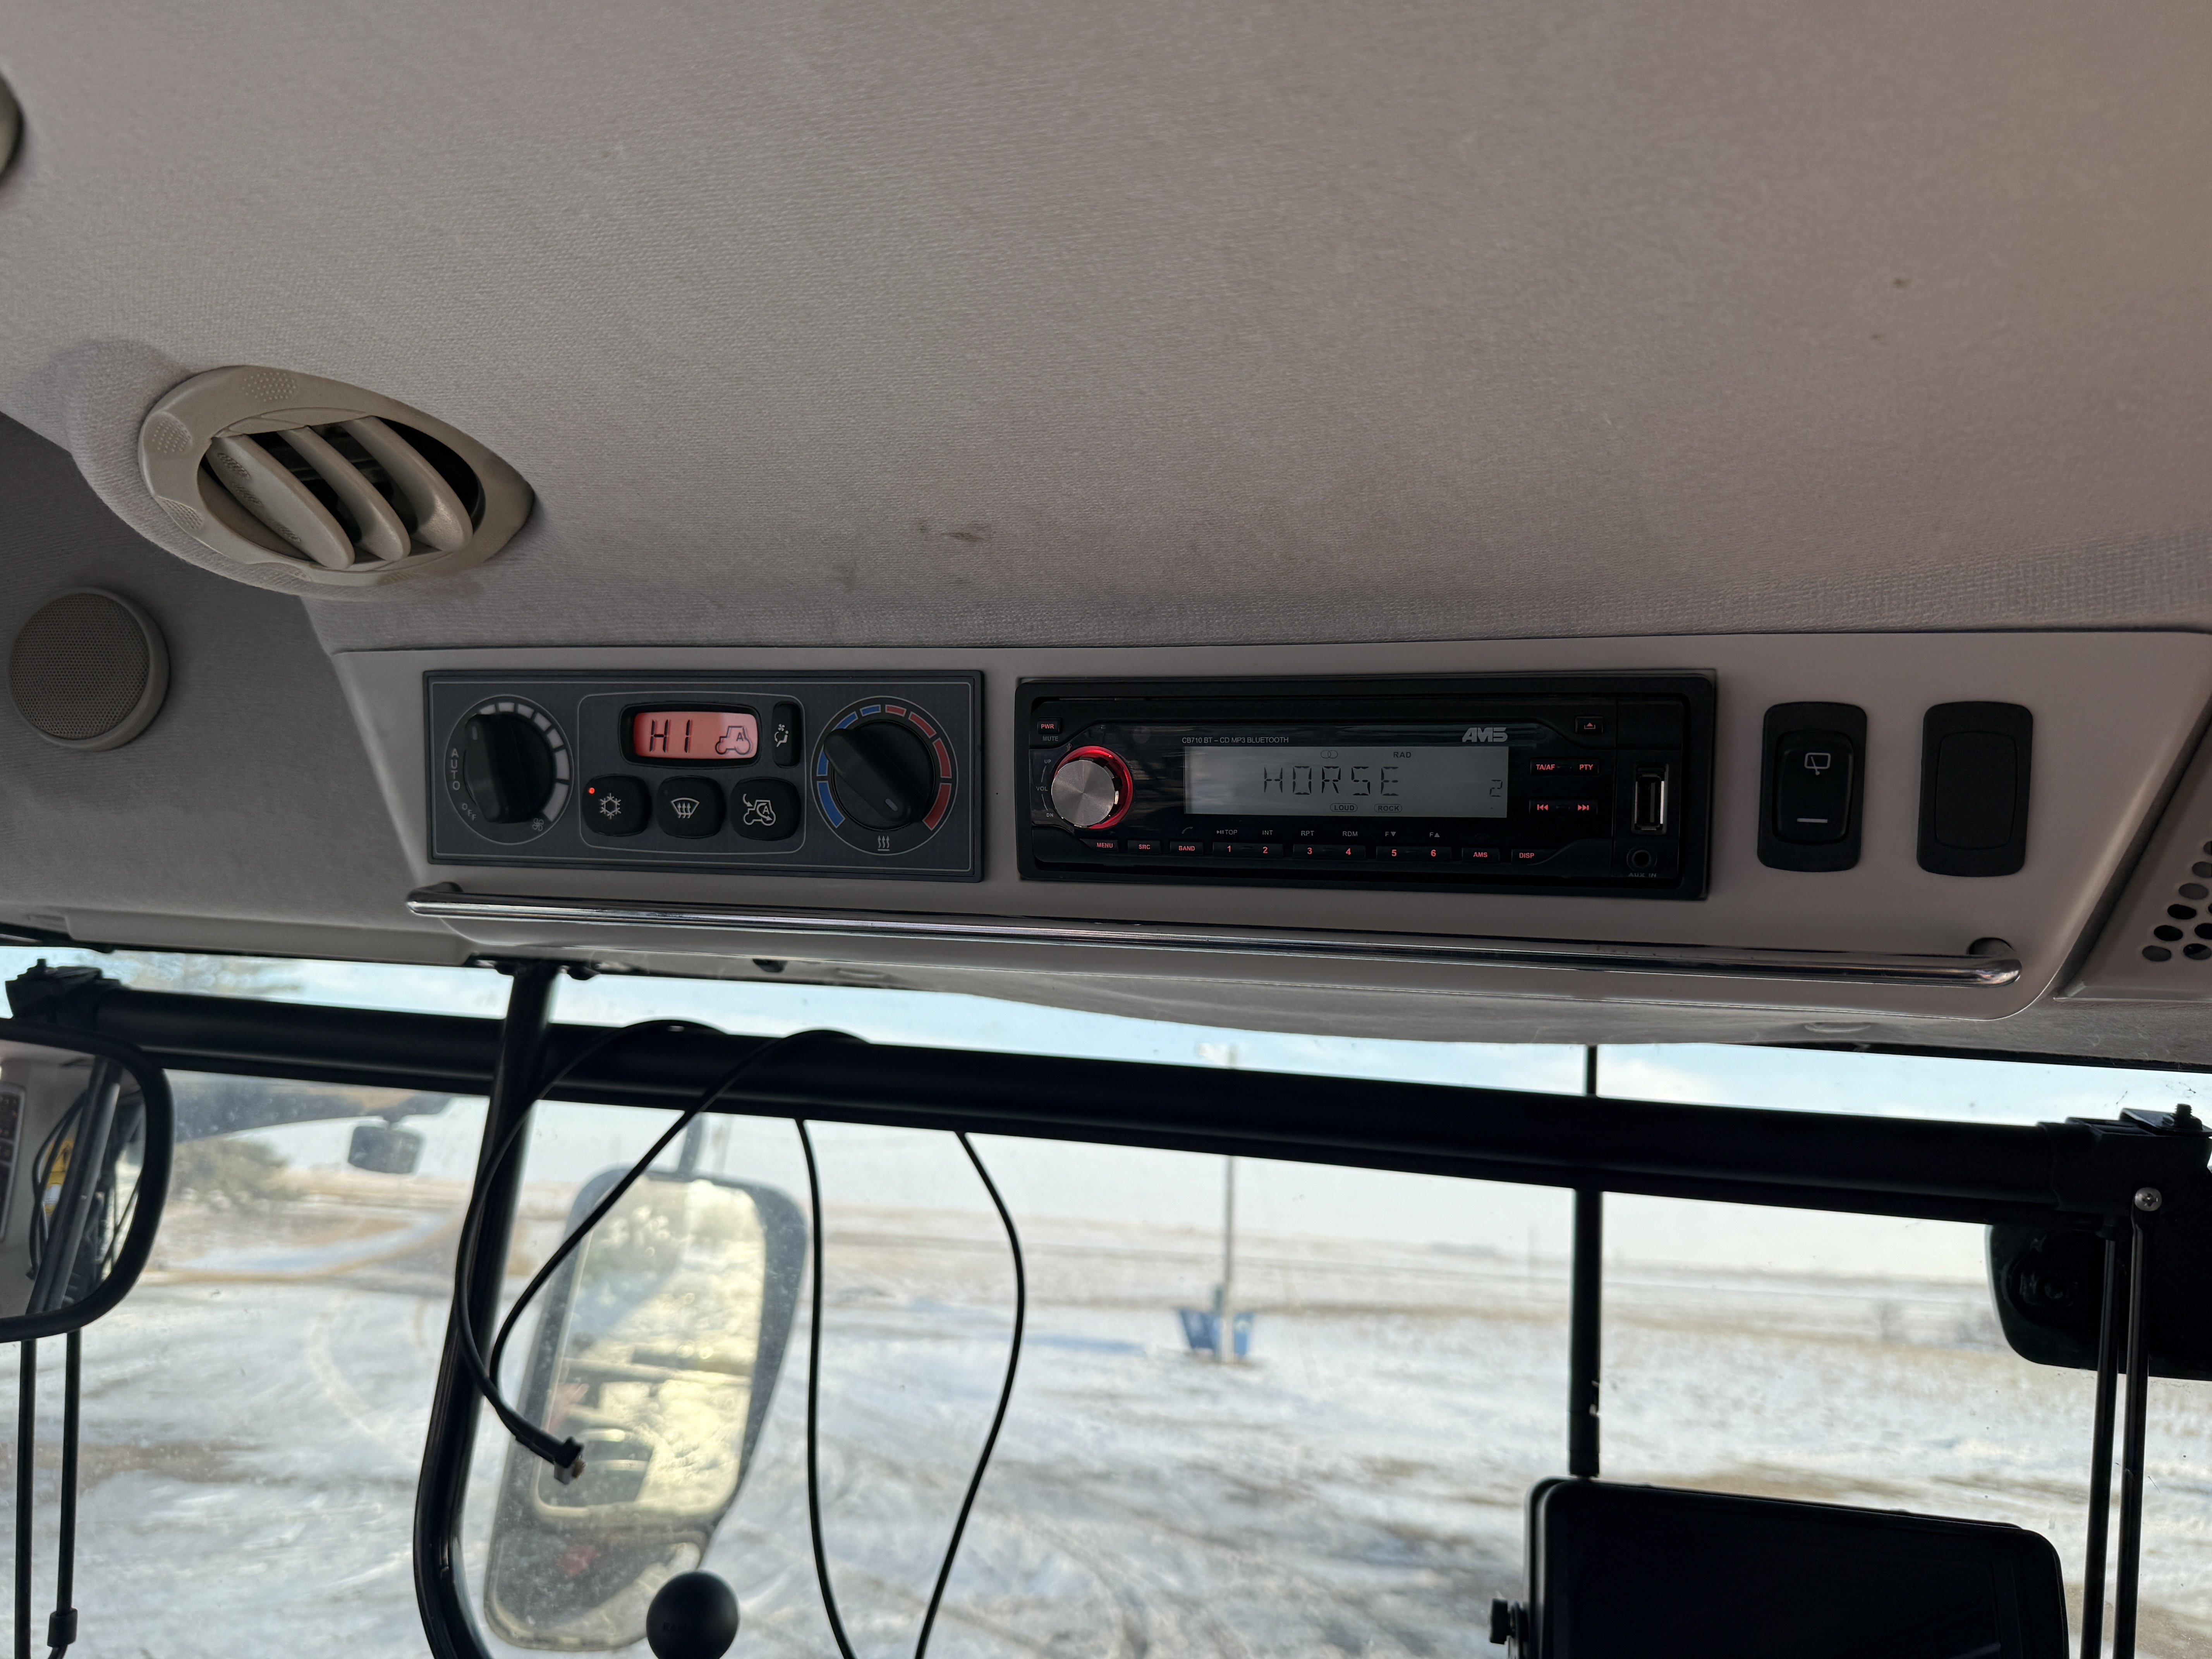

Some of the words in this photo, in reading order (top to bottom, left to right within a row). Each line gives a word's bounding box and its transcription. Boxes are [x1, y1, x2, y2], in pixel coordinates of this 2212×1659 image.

[1462, 727, 1508, 742] AMS
[450, 748, 460, 790] AUTO
[1264, 766, 1399, 796] HORSE
[1489, 780, 1503, 797] 2
[462, 803, 476, 821] OFF
